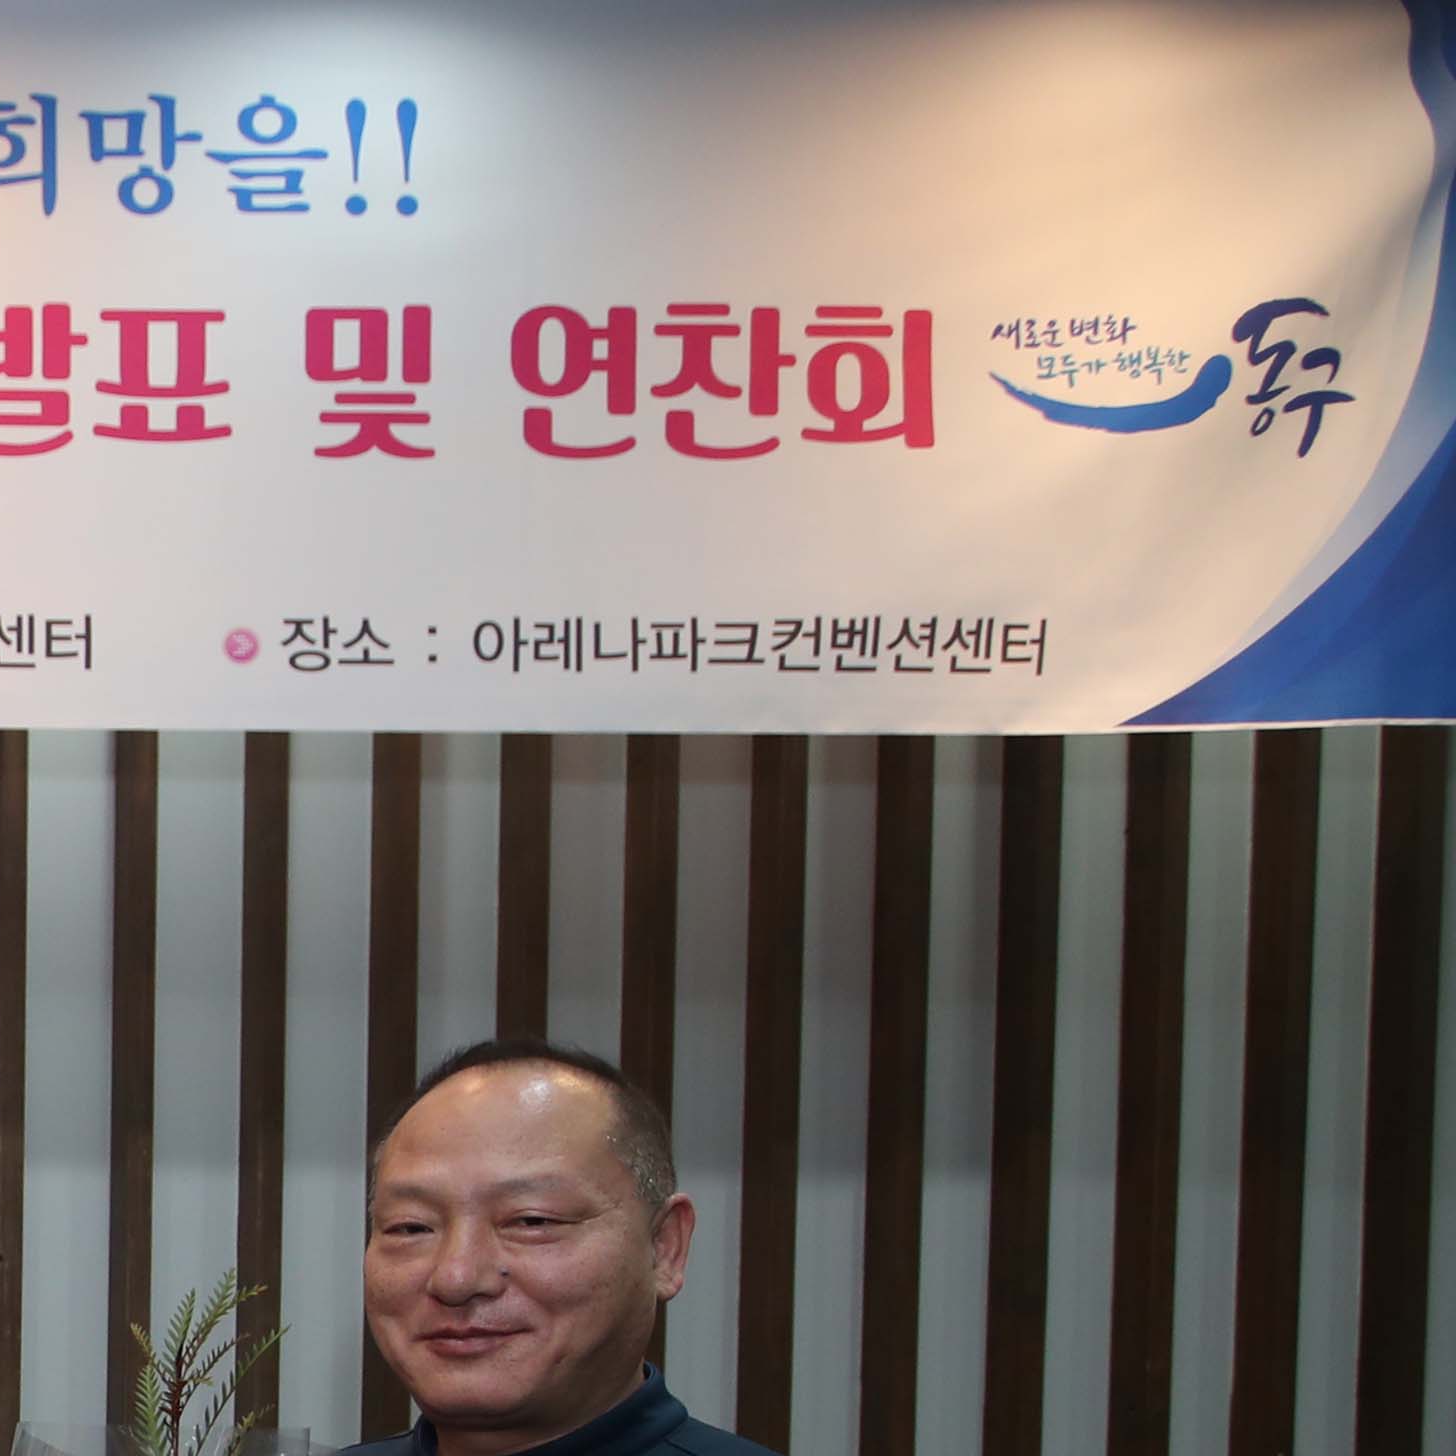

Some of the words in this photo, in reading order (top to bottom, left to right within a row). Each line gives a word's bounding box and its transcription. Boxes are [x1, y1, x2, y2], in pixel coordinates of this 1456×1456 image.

[990, 314, 1066, 351] 새로운
[1068, 311, 1137, 346] 변화
[305, 306, 435, 458] 및
[511, 304, 934, 457] 연찬회
[1230, 295, 1358, 460] 동구
[1035, 355, 1107, 388] 모두가
[1112, 346, 1192, 386] 행복한
[282, 617, 394, 671] 장소
[474, 617, 1046, 675] 아레나파크컨벤션센터
